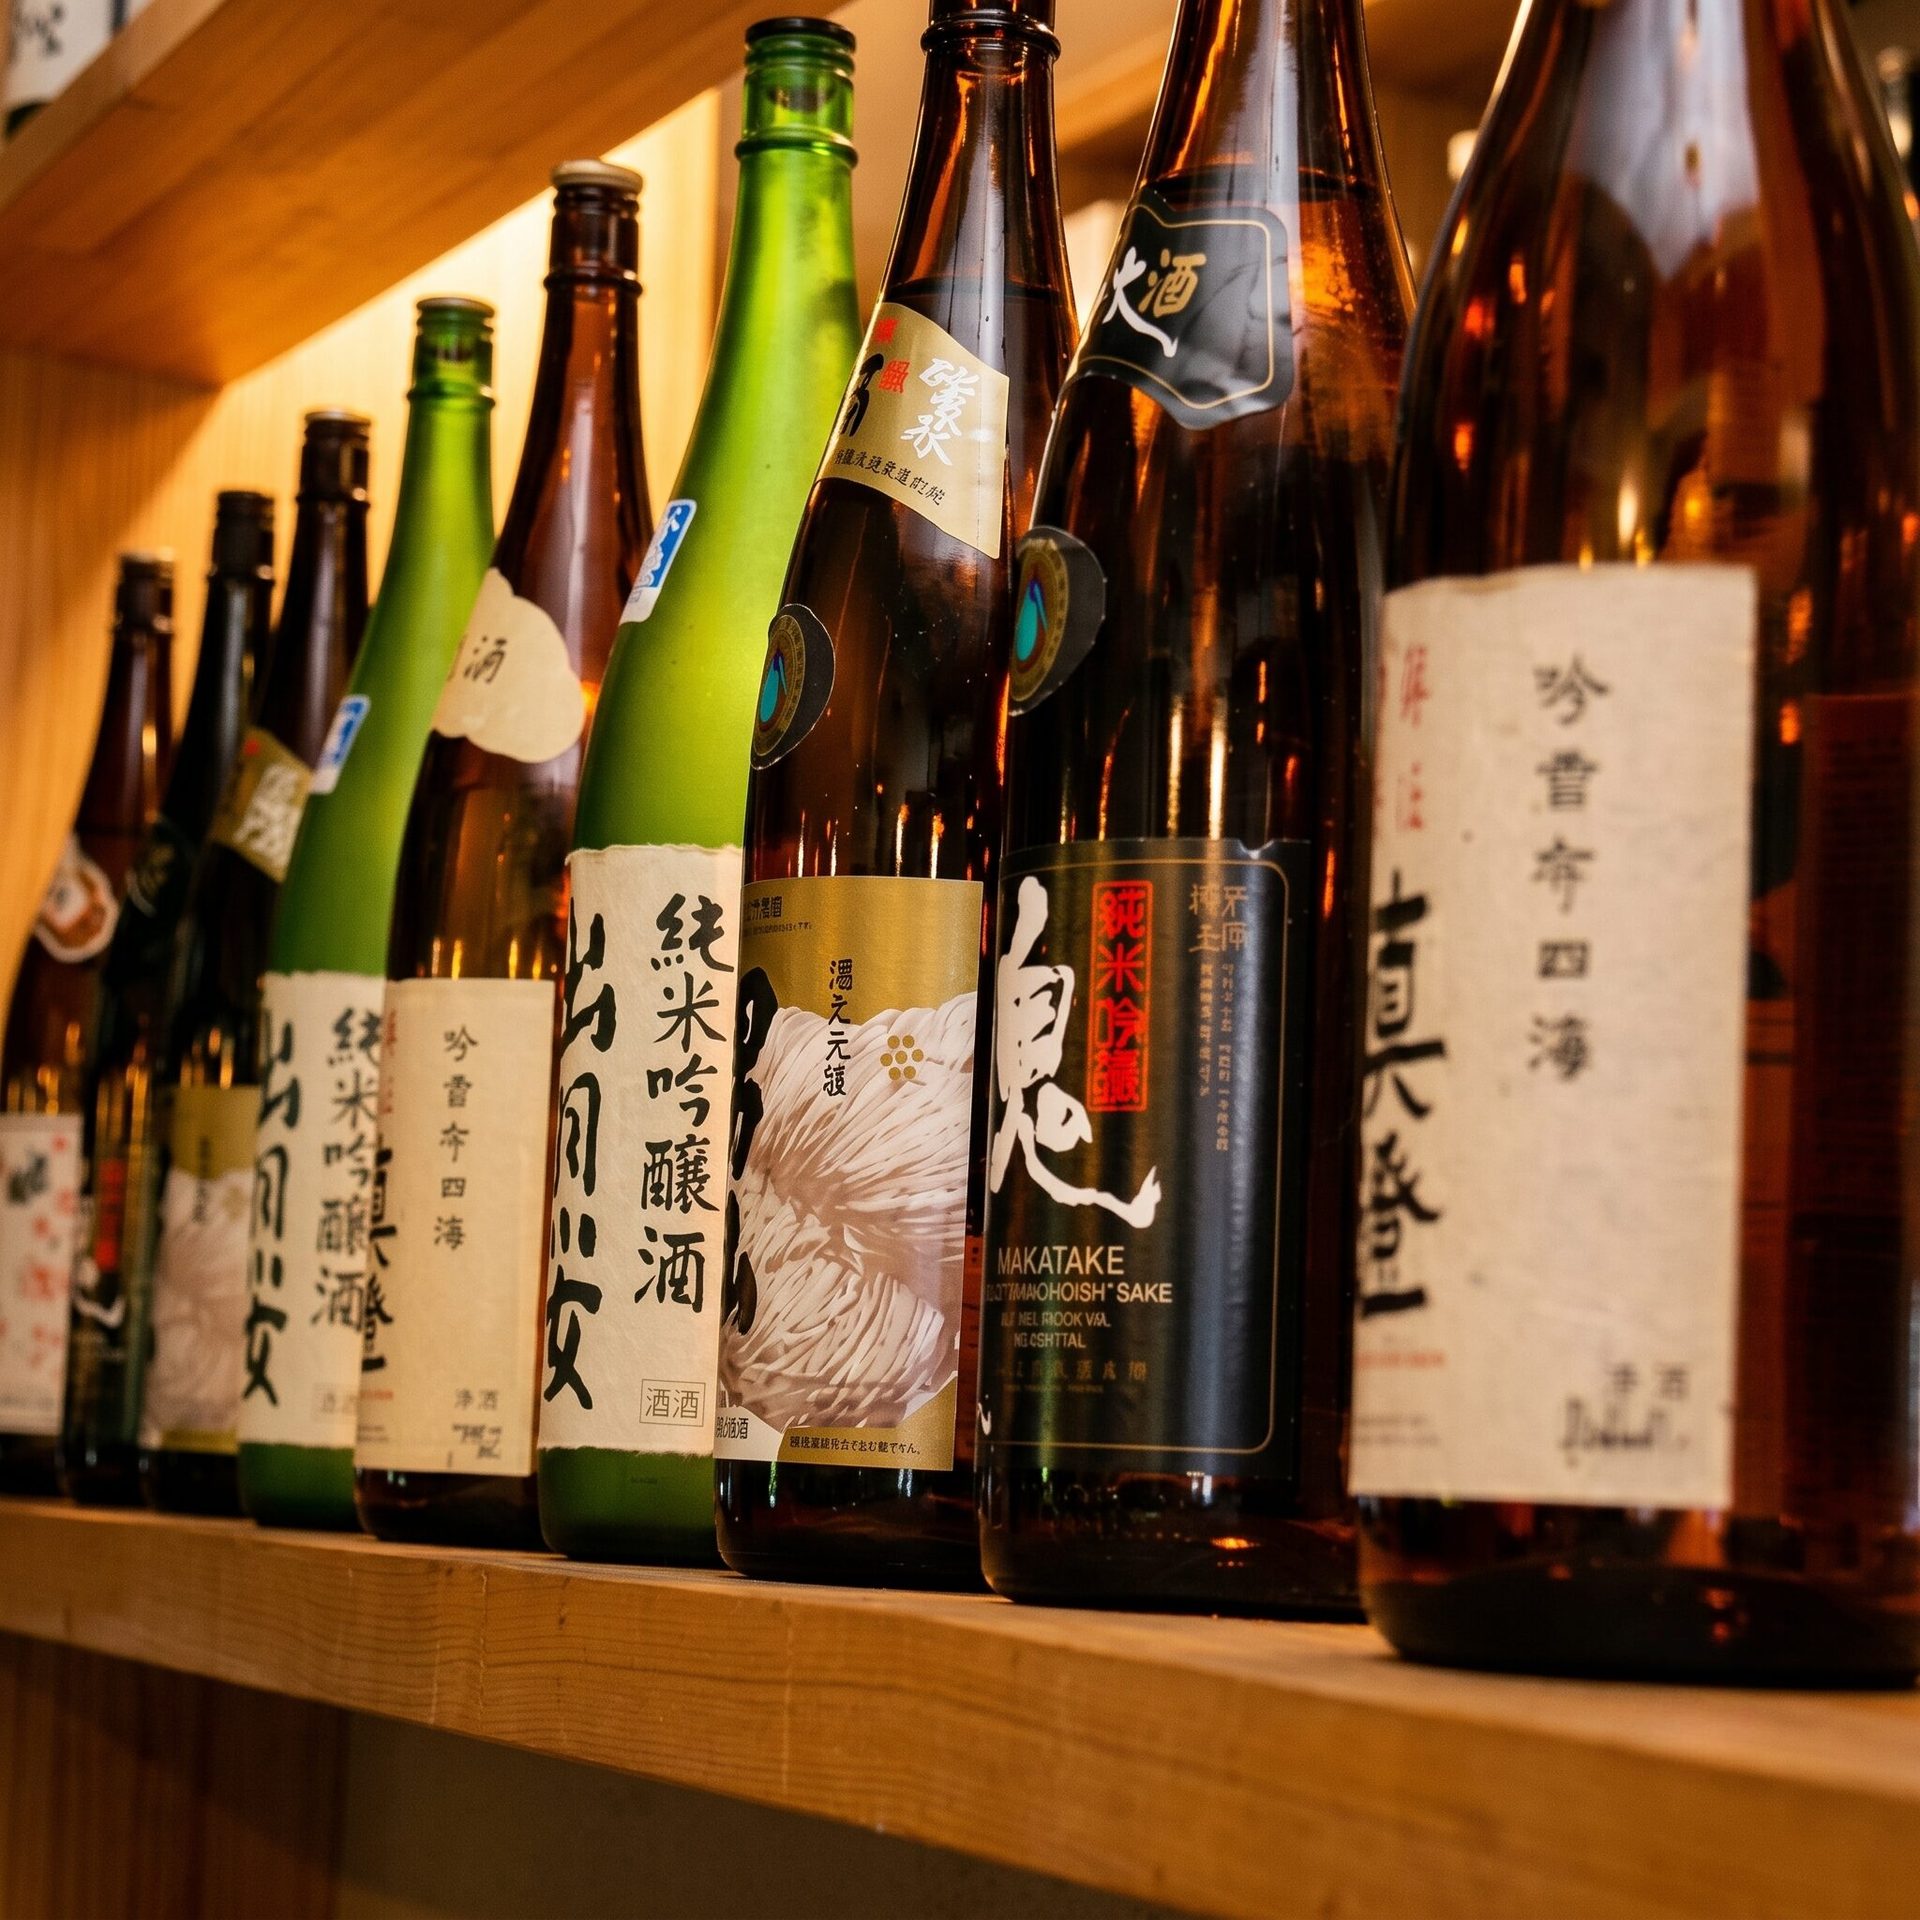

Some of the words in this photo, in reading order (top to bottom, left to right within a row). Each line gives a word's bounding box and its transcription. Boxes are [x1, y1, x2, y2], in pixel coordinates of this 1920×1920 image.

[1138, 249, 1207, 318] 酒
[634, 893, 736, 1313] 純米吟醸酒
[998, 1246, 1125, 1276] MAKATAKE
[1116, 1282, 1173, 1303] SAKE
[645, 1387, 700, 1419] 酒酒
